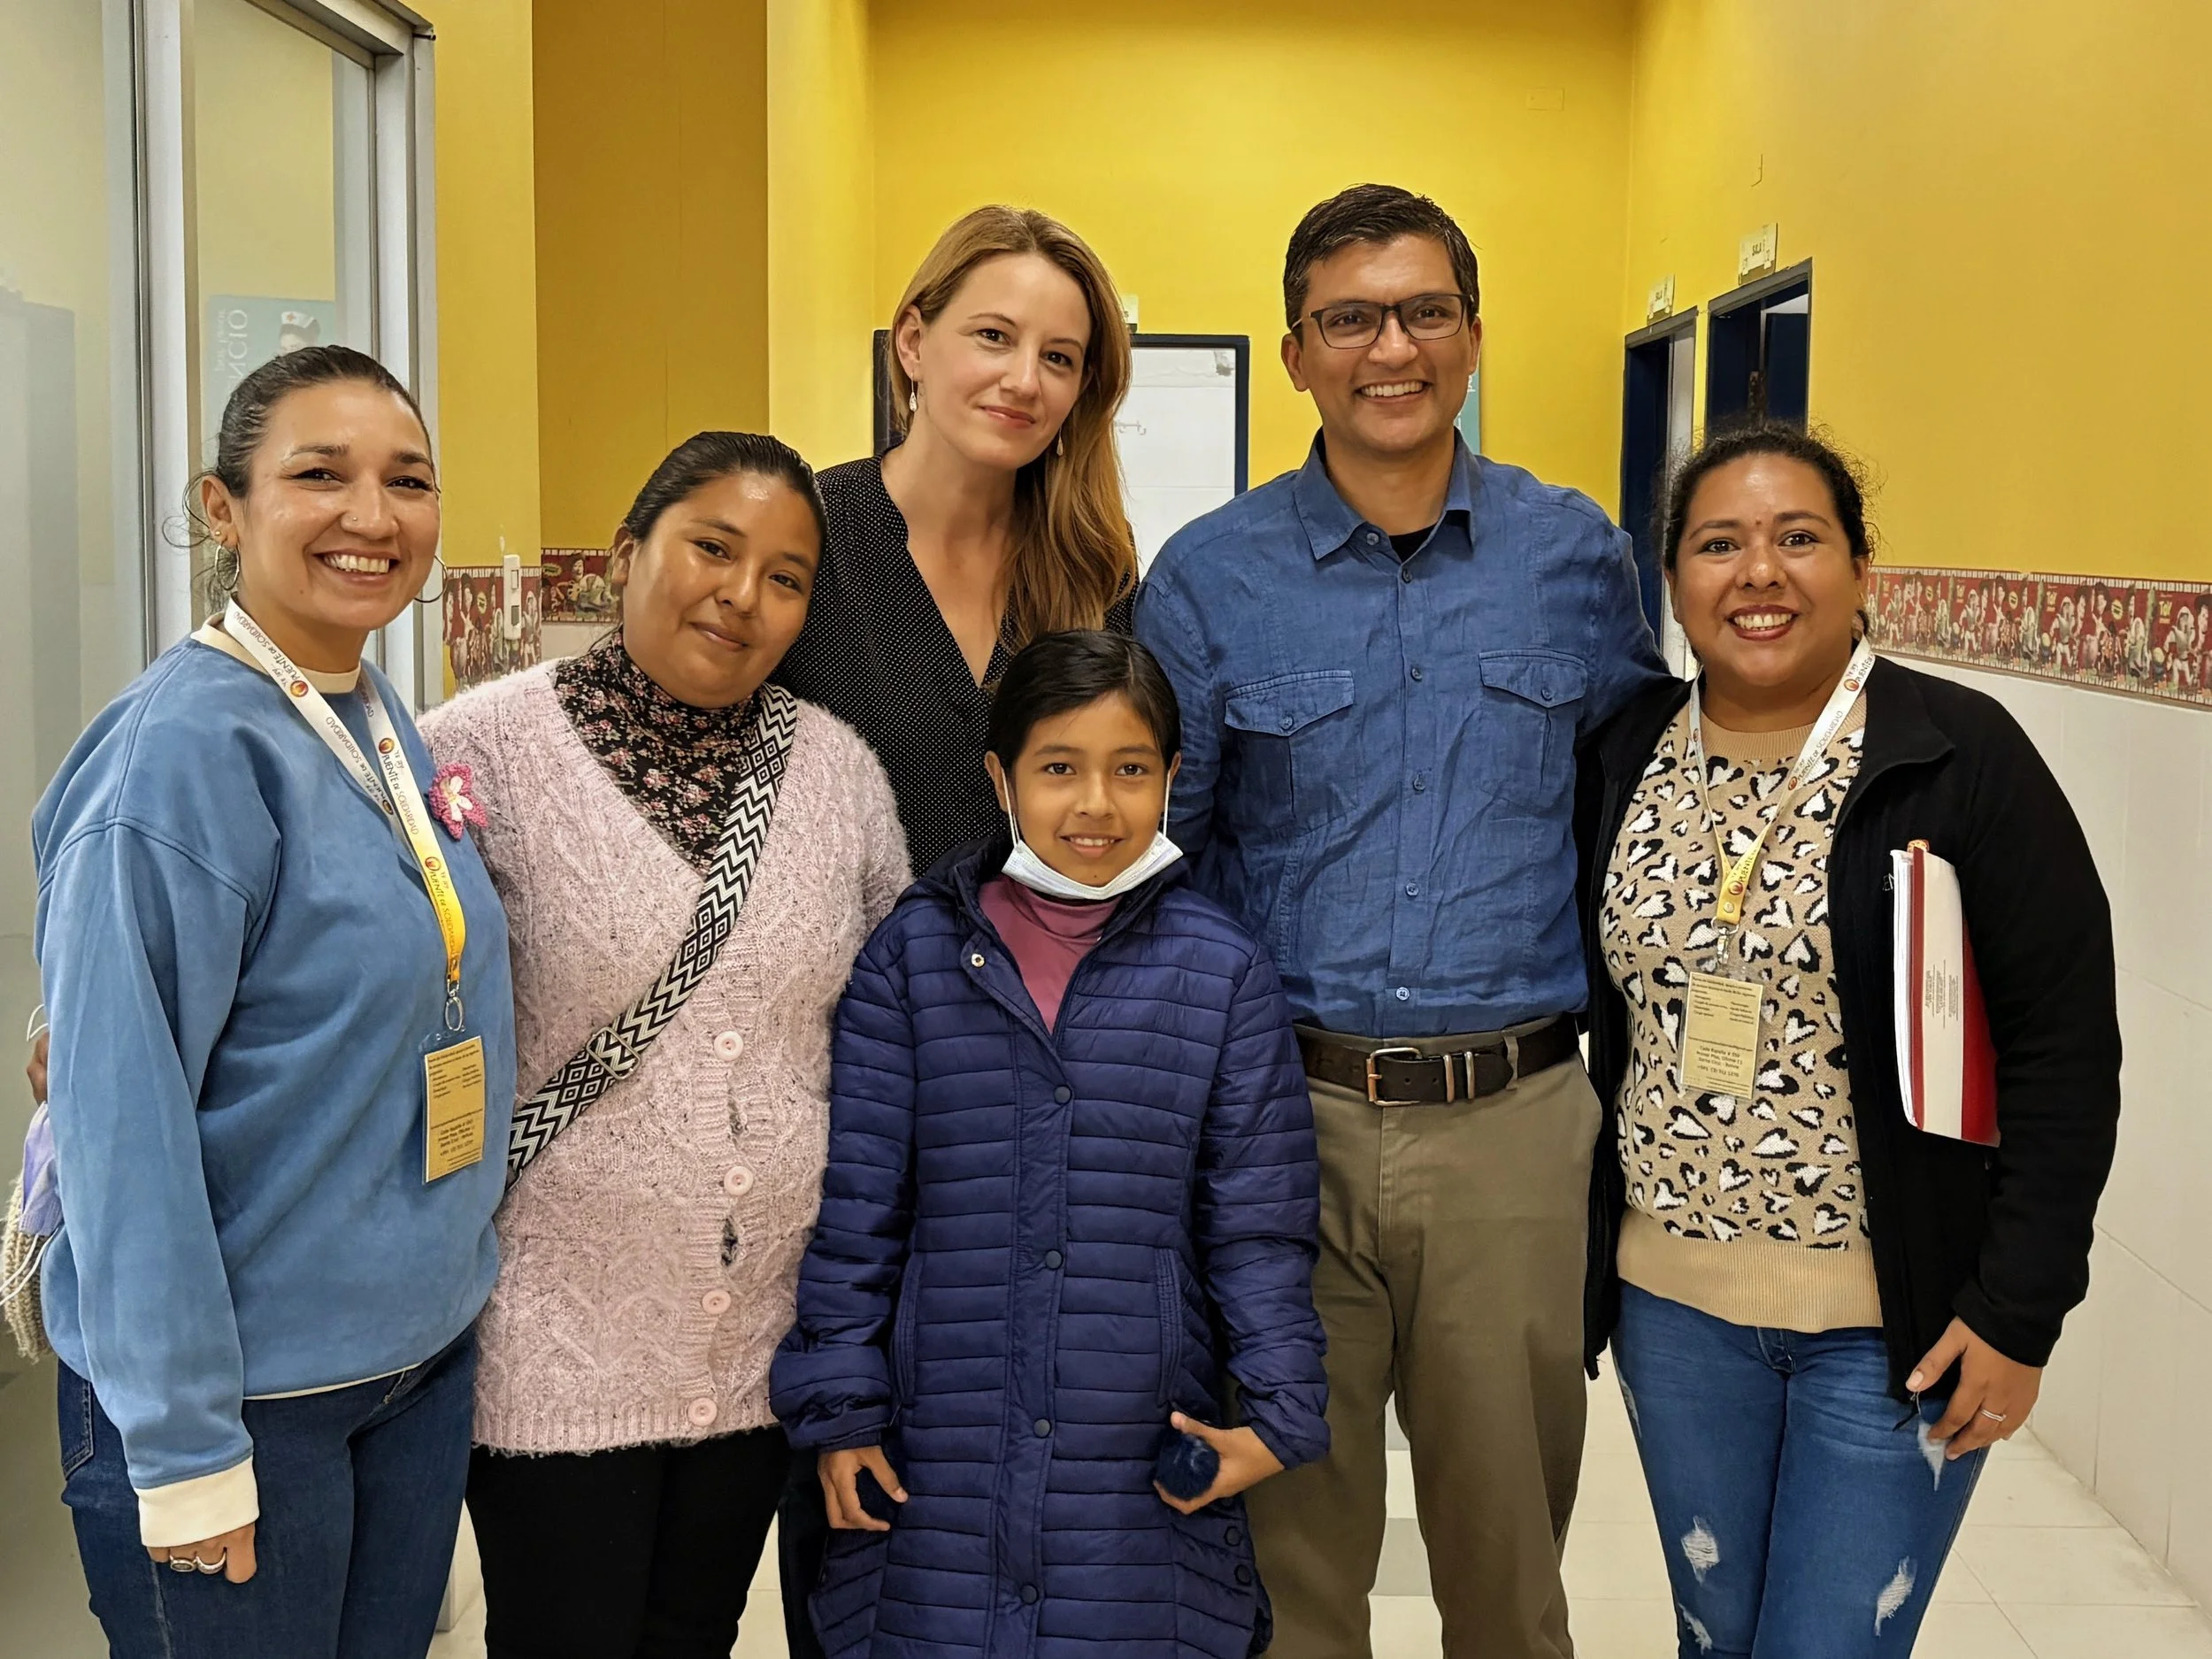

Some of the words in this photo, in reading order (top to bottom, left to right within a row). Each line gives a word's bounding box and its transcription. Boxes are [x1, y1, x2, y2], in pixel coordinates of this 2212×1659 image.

[232, 610, 271, 649] SOLIDARIDAD
[273, 652, 301, 682] PUENTE
[1855, 659, 1871, 682] PUENTE
[325, 715, 363, 764] SOLIDARIDAD
[364, 772, 387, 800] PUENTE
[380, 754, 399, 783] PUENTE
[396, 790, 420, 836] SOLIDARIDAD
[428, 871, 445, 898] PUENTE
